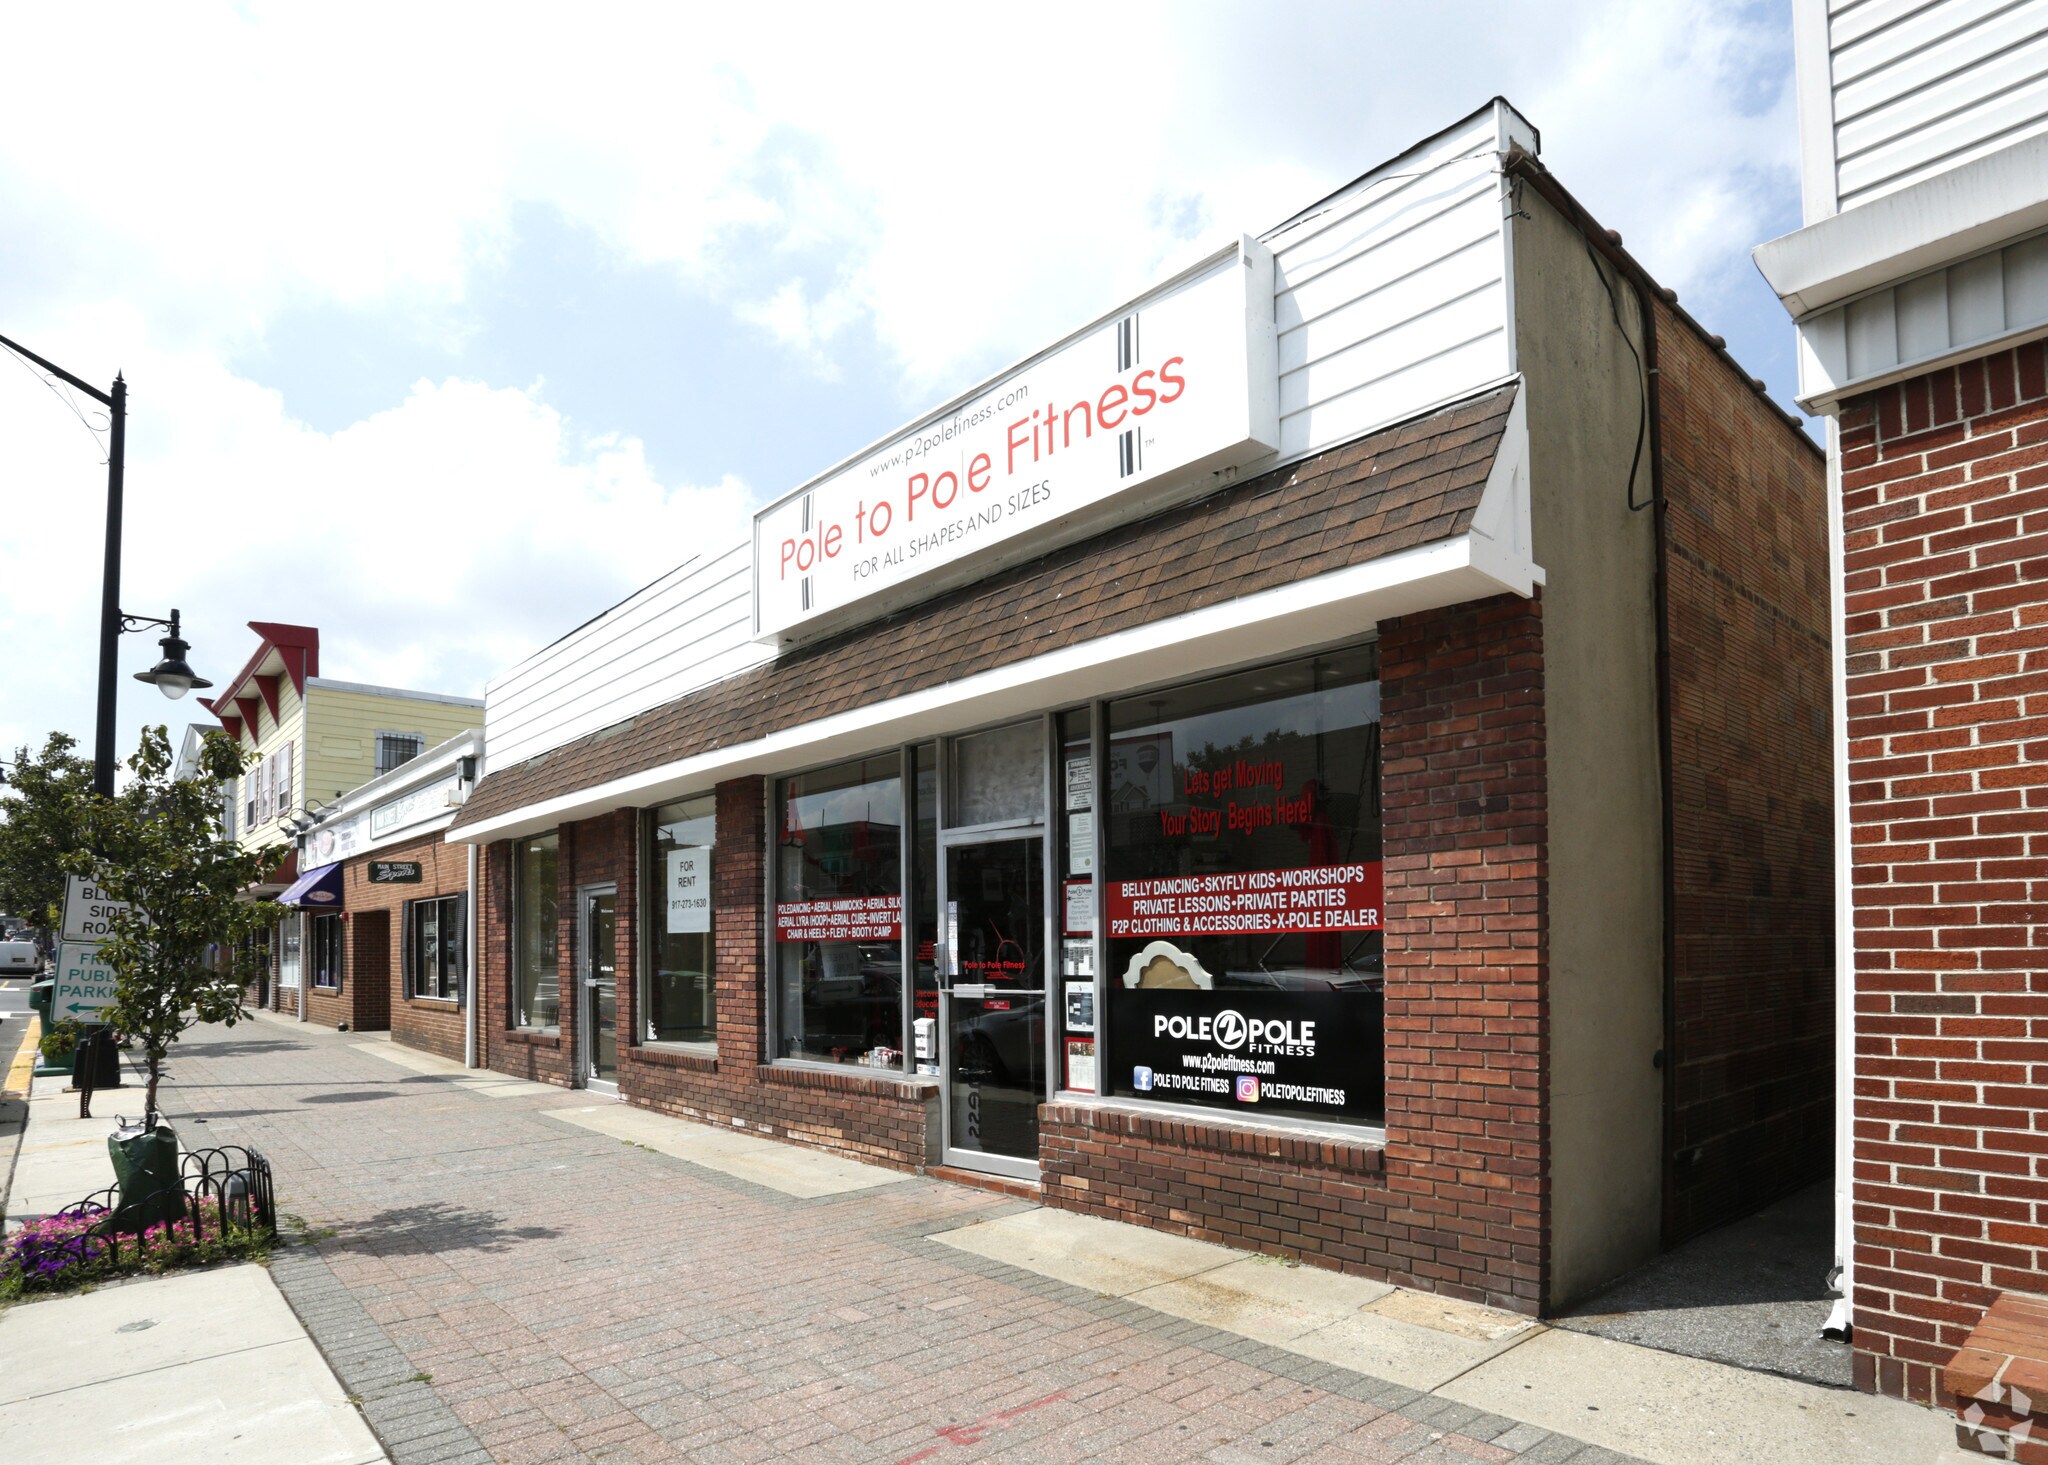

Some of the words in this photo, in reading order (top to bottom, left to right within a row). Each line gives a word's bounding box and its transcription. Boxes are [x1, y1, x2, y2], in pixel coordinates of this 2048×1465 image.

[870, 385, 1028, 477] www.p2polefiness.com
[781, 520, 842, 580] Pole
[856, 500, 892, 544] to
[908, 452, 992, 522] Pole
[1007, 356, 1186, 475] Fitness
[853, 557, 878, 581] FOR
[883, 546, 904, 569] ALL
[910, 520, 963, 558] SHAPES
[965, 503, 1002, 535] AND
[1008, 480, 1051, 516] SIZES
[1184, 768, 1210, 795] Lets
[1213, 767, 1233, 798] get
[1236, 757, 1283, 791] Moving
[1161, 810, 1187, 837] Your
[1189, 805, 1222, 838] Story
[1228, 802, 1272, 836] Begins
[1275, 793, 1313, 824] Here!
[680, 861, 694, 872] FOR
[678, 876, 696, 887] RENT
[1122, 881, 1151, 897] BELLY
[1153, 878, 1200, 895] DANCING
[1204, 874, 1247, 893] SKYFLY
[1249, 872, 1276, 890] KIDS
[1281, 866, 1364, 888] WORKSHOPS
[672, 898, 707, 909] 917-273-1630
[778, 903, 811, 914] POLEDANCING
[814, 901, 832, 912] AERIAL
[832, 899, 864, 911] HAMMOCKS
[866, 898, 887, 909] AERIAL
[1133, 899, 1176, 915] PRIVATE
[1178, 895, 1231, 913] LESSONS
[1236, 892, 1288, 911] PRIVATE
[1291, 888, 1346, 908] PARTIES
[83, 922, 118, 934] ROA
[778, 916, 795, 927] AERIAL
[796, 915, 809, 926] LYRA
[830, 913, 850, 925] AERIAL
[851, 913, 867, 924] CUBE
[869, 911, 891, 923] INVERT
[1112, 918, 1129, 934] P2P
[1131, 916, 1181, 934] CLOTHING
[1183, 917, 1191, 932] &
[1192, 913, 1271, 932] ACCESSORIES
[1277, 911, 1322, 929] X-POLE
[1325, 908, 1378, 927] DEALER
[787, 929, 803, 939] CHAIR
[804, 929, 808, 938] &
[809, 928, 826, 938] HEELS
[830, 927, 848, 938] FLEXY
[852, 927, 873, 937] BOOTY
[873, 926, 892, 937] CAMP
[69, 969, 115, 981] PUBL
[964, 961, 978, 969] Pole
[987, 961, 1002, 969] Pole
[1003, 961, 1025, 969] Fitness
[1154, 1015, 1212, 1040] POLE
[1216, 1012, 1245, 1046] 2
[1249, 1019, 1316, 1046] POLE
[1249, 1043, 1316, 1057] FITNESS
[1182, 1053, 1275, 1075] www.p2polefitness.com
[1153, 1072, 1170, 1088] POLE
[1171, 1075, 1181, 1089] TO
[1182, 1075, 1200, 1090] POLE
[1201, 1077, 1230, 1094] FITNESS
[1261, 1083, 1345, 1106] POLETOPOLEFITNESS
